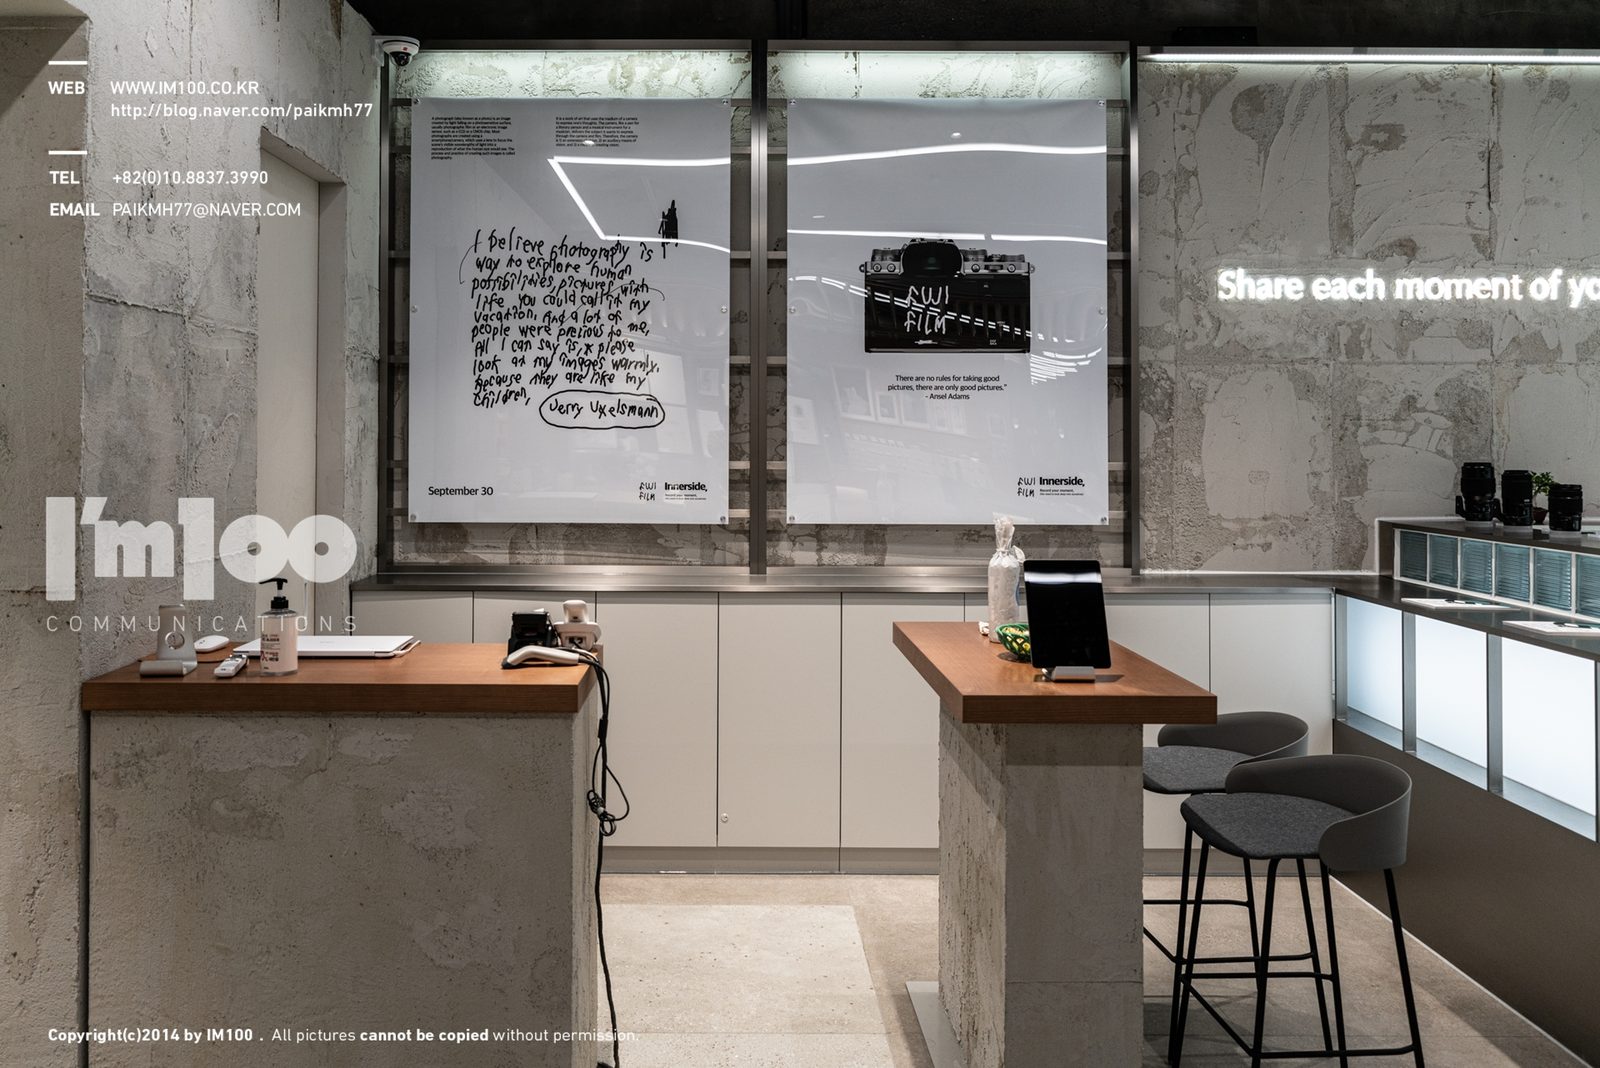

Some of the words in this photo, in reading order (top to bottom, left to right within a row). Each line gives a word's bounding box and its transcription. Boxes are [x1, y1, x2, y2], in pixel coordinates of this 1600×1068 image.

[488, 226, 544, 256] believe
[549, 234, 630, 269] photography
[640, 241, 653, 262] is
[476, 256, 500, 280] way
[506, 254, 522, 268] to
[527, 256, 580, 276] explore
[591, 260, 631, 280] human
[556, 276, 613, 296] pictures
[621, 278, 648, 296] with
[1217, 269, 1303, 300] Share
[1312, 268, 1385, 300] each
[1394, 274, 1524, 301] moment
[1529, 268, 1563, 301] of
[476, 293, 504, 311] life
[543, 290, 575, 307] could
[581, 290, 603, 308] call
[606, 293, 622, 309] it
[630, 299, 650, 315] my
[571, 311, 578, 323] a
[583, 309, 601, 324] lot
[608, 310, 622, 325] of
[904, 311, 946, 335] FILM
[472, 323, 510, 343] people
[519, 325, 552, 338] were
[608, 325, 622, 342] to
[475, 337, 489, 357] All
[511, 340, 532, 352] can
[537, 338, 560, 363] say
[597, 338, 635, 359] please
[473, 355, 501, 376] look
[511, 355, 526, 367] at
[534, 354, 553, 376] my
[559, 352, 605, 378] images
[529, 371, 558, 390] they
[566, 373, 584, 383] are
[590, 371, 615, 387] like
[626, 373, 646, 390] my
[963, 375, 983, 383] taking
[983, 375, 1000, 383] good
[550, 399, 583, 419] Jerry
[428, 486, 479, 497] September
[481, 486, 494, 496] 30
[664, 482, 708, 492] Innerside,
[1039, 477, 1086, 487] Innerside,
